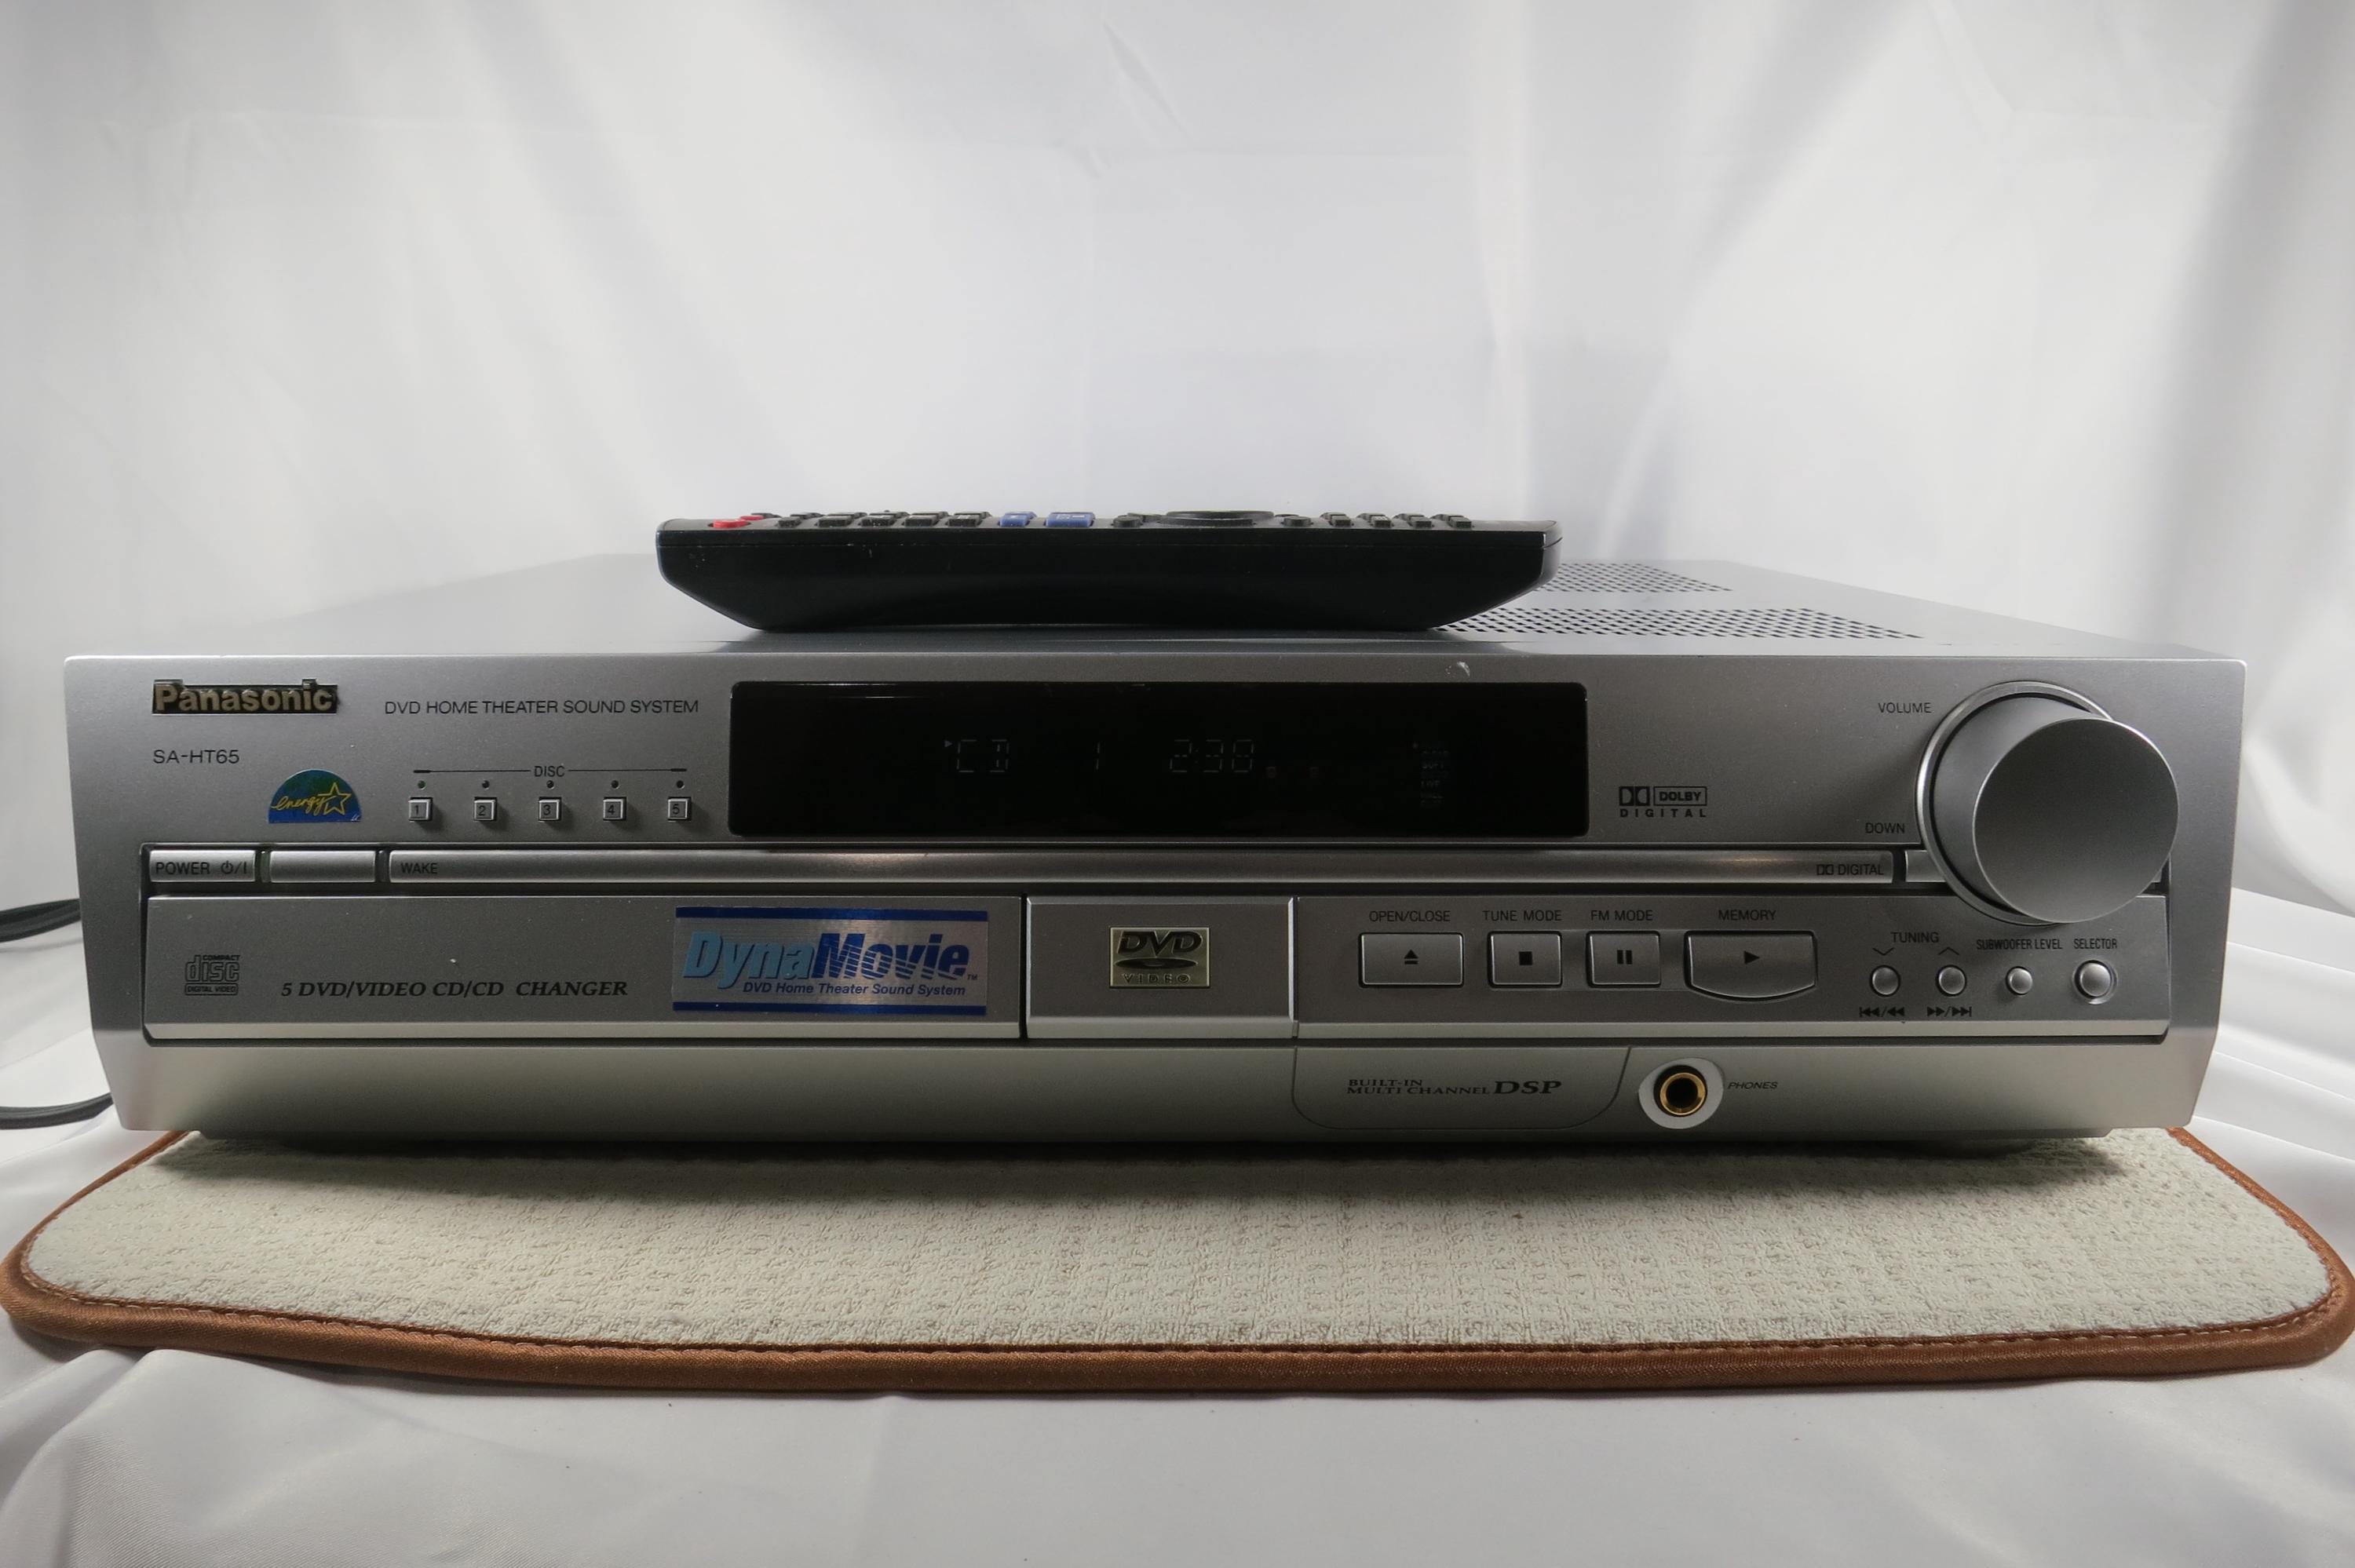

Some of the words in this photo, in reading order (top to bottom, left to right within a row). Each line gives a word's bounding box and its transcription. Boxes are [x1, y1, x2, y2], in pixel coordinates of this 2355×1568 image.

[155, 680, 334, 712] Panasonic
[385, 701, 421, 714] DVD
[426, 701, 477, 714] HOME
[481, 700, 558, 713] THEATER
[563, 700, 626, 713] SOUND
[630, 699, 699, 713] SYSTEM
[1878, 702, 1932, 714] VOLUME
[152, 749, 240, 765] SA-HT65
[534, 765, 565, 778] DISC
[1658, 791, 1702, 802] DOLBY
[271, 794, 330, 816] energy
[478, 805, 487, 816] 2
[542, 804, 551, 815] 3
[607, 804, 615, 815] 4
[672, 804, 681, 815] 5
[1619, 808, 1707, 818] DIGITAL
[1865, 822, 1906, 833] DOWN
[155, 862, 210, 875] POWER
[400, 862, 438, 875] WAKE
[1838, 864, 1884, 876] DIGITAL
[1369, 910, 1451, 922] OPEN/CLOSE
[1483, 909, 1519, 921] TUNE
[1523, 909, 1562, 921] MODE
[1590, 909, 1611, 921] FM
[1614, 909, 1654, 921] MODE
[1718, 909, 1776, 921] MEMORY
[1116, 930, 1203, 955] DVD
[1890, 932, 1940, 943] TUNING
[1976, 939, 2032, 950] SUBWOOFER
[2036, 939, 2063, 950] LEVEL
[2073, 938, 2118, 950] SELECTOR
[682, 930, 969, 990] DynaMovie
[184, 954, 240, 983] disc
[1121, 973, 1191, 983] VIDEO
[280, 982, 292, 997] 5
[298, 981, 427, 998] DVD/VIDEO
[432, 981, 504, 998] CD/CD
[516, 981, 628, 997] CHANGER
[743, 984, 772, 994] DVD
[776, 984, 814, 994] Home
[819, 984, 869, 995] Theater
[872, 984, 913, 995] Sound
[917, 985, 966, 997] System
[1493, 1080, 1562, 1094] DSP
[1727, 1081, 1778, 1090] PHONES
